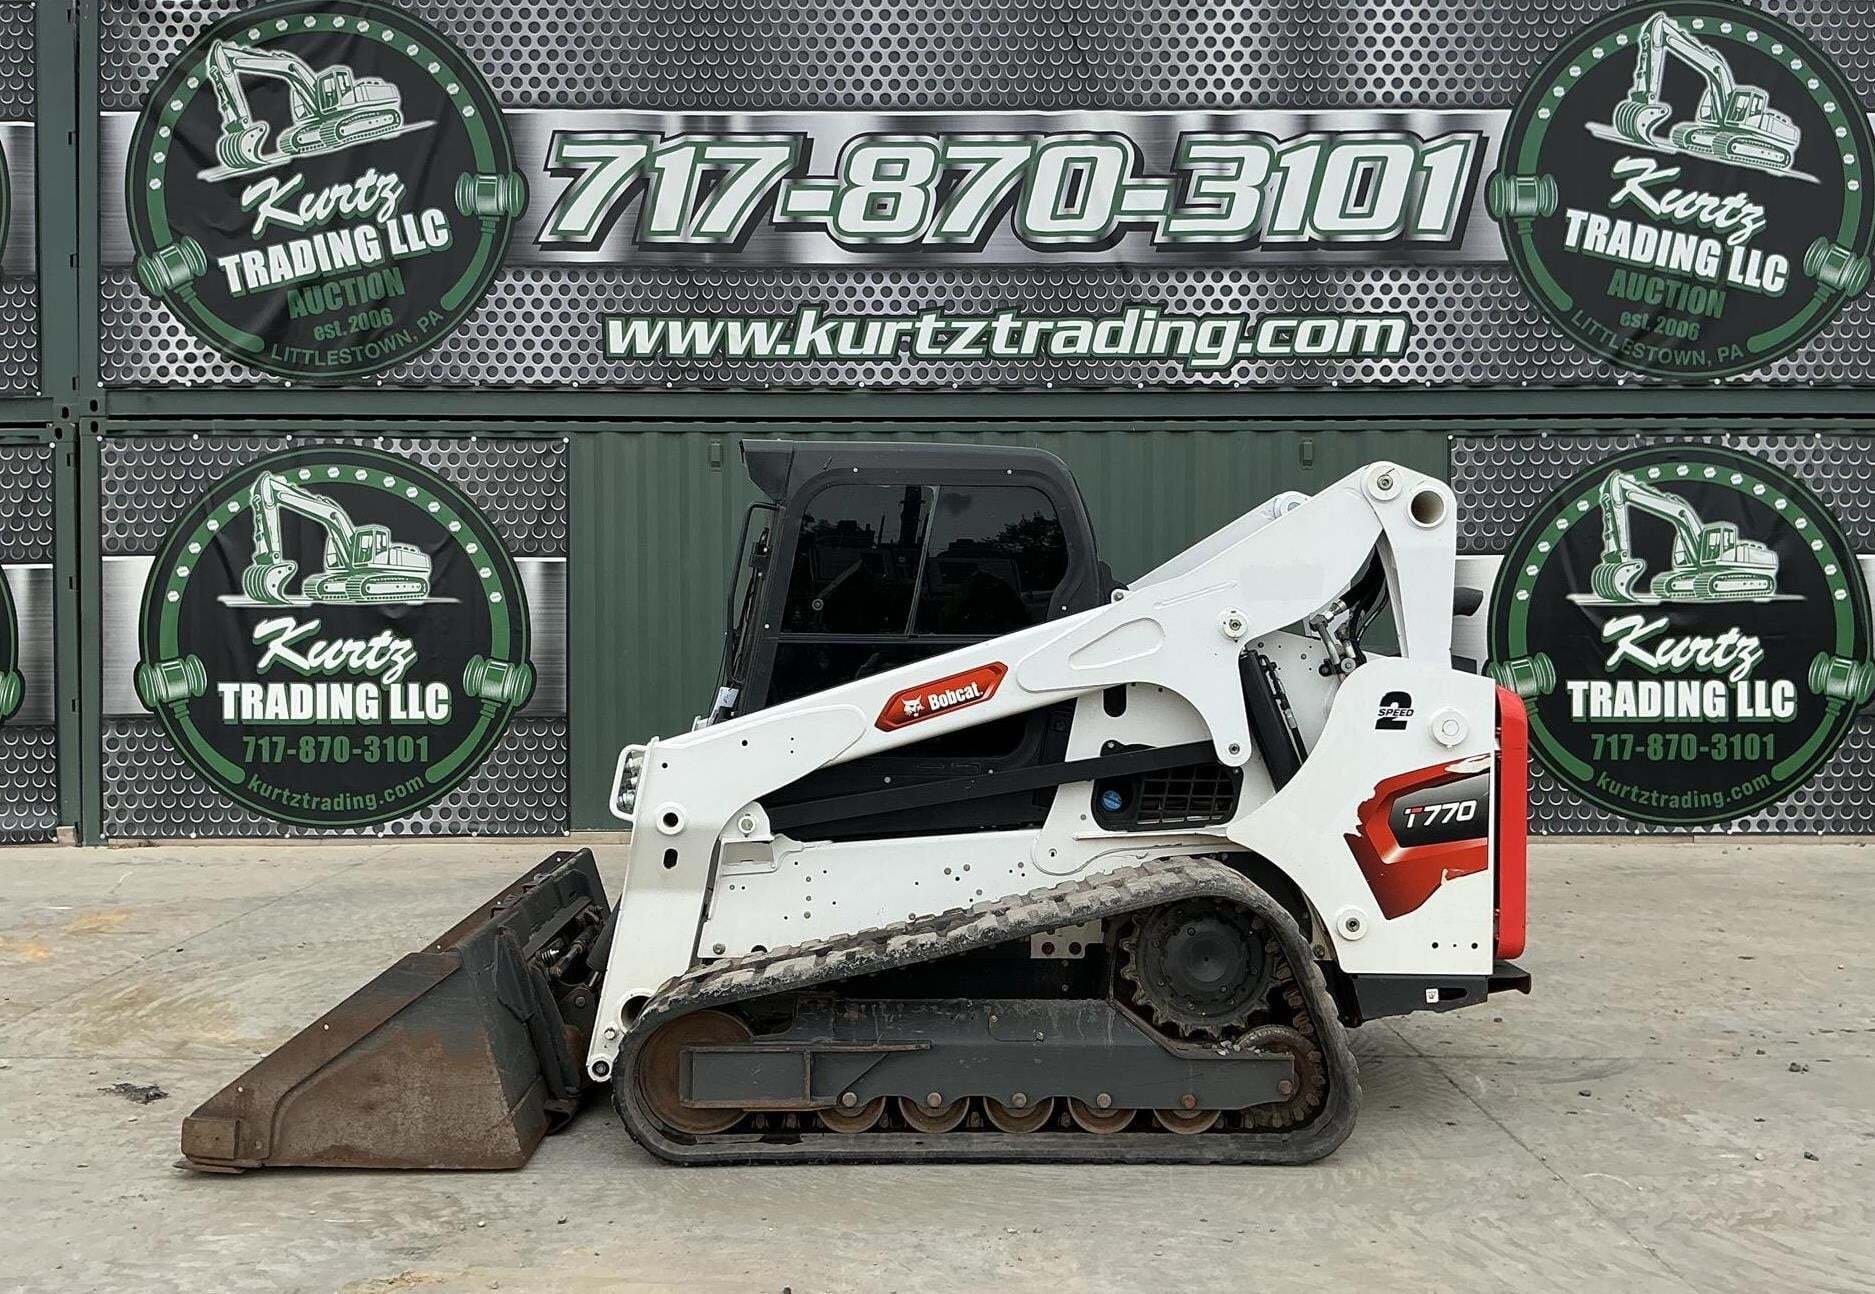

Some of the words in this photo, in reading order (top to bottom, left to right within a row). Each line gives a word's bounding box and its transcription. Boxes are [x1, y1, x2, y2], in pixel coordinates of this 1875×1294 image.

[241, 168, 405, 238] Kurtz
[546, 137, 1471, 238] 717-870-3101
[1608, 156, 1765, 246] Kurtz
[218, 224, 384, 295] TRADING
[386, 208, 452, 259] LLC
[1565, 208, 1722, 282] TRADING
[1727, 246, 1790, 296] LLC
[287, 267, 405, 319] AUCTION
[1607, 268, 1726, 319] AUCTION
[271, 329, 419, 366] LITTLESTOWN,
[416, 309, 444, 334] PA
[313, 319, 347, 340] est.
[349, 307, 394, 333] 2006
[605, 306, 1408, 370] www.kurtztrading.com
[1571, 310, 1712, 366] LITTLESTOWN,
[1717, 344, 1744, 363] PA
[1656, 316, 1700, 340] 2006
[253, 617, 417, 689] Kurtz
[1601, 615, 1764, 686] Kurtz
[217, 682, 382, 724] TRADING
[390, 682, 452, 724] LLC
[928, 681, 980, 710] Bobcat
[1375, 691, 1412, 730] 2
[1378, 708, 1414, 717] SPEED
[1566, 680, 1729, 722] TRADING
[1737, 680, 1797, 722] LLC
[243, 735, 429, 763] 717-870-3101
[1591, 733, 1774, 760] 717-870-3101
[248, 774, 425, 811] kurtztrading.com
[1596, 771, 1771, 808] kurtztrading.com
[1404, 800, 1477, 828] T770
